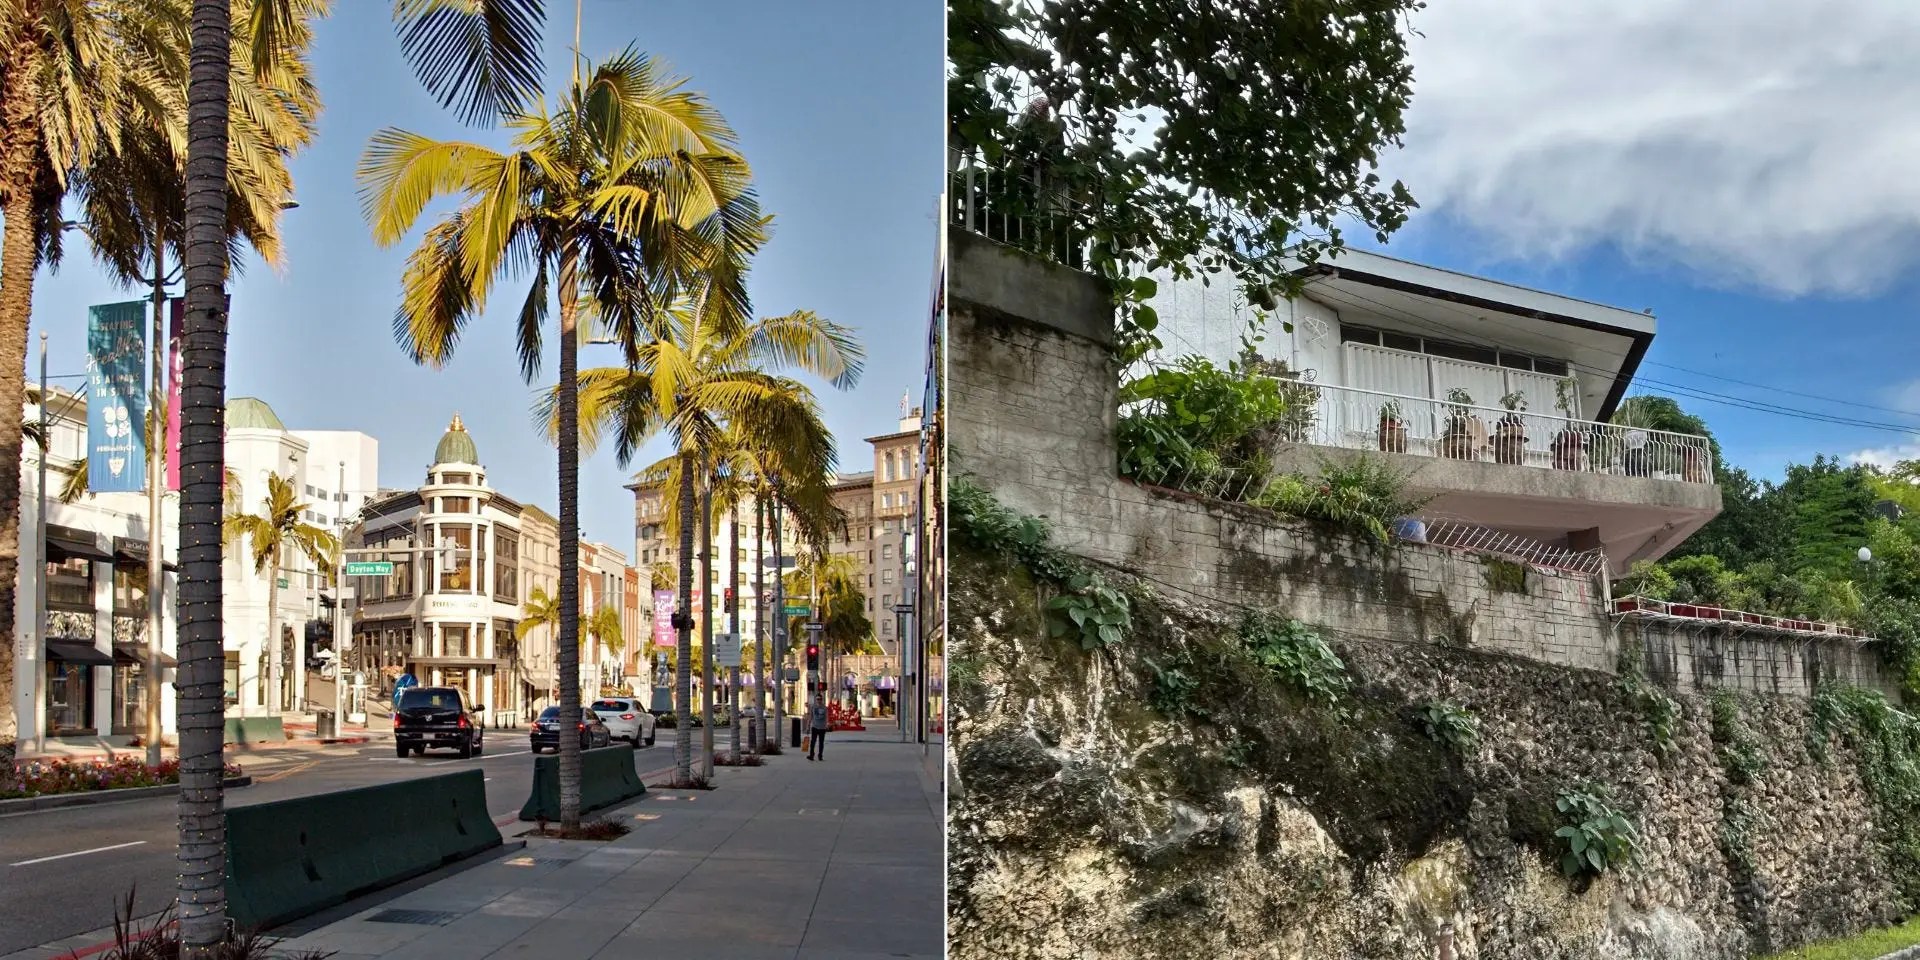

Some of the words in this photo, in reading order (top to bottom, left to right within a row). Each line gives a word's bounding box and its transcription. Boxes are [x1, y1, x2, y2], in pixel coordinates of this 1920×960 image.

[92, 375, 101, 385] IS
[96, 386, 107, 398] IN
[350, 565, 374, 574] Dayton
[375, 565, 389, 574] Way
